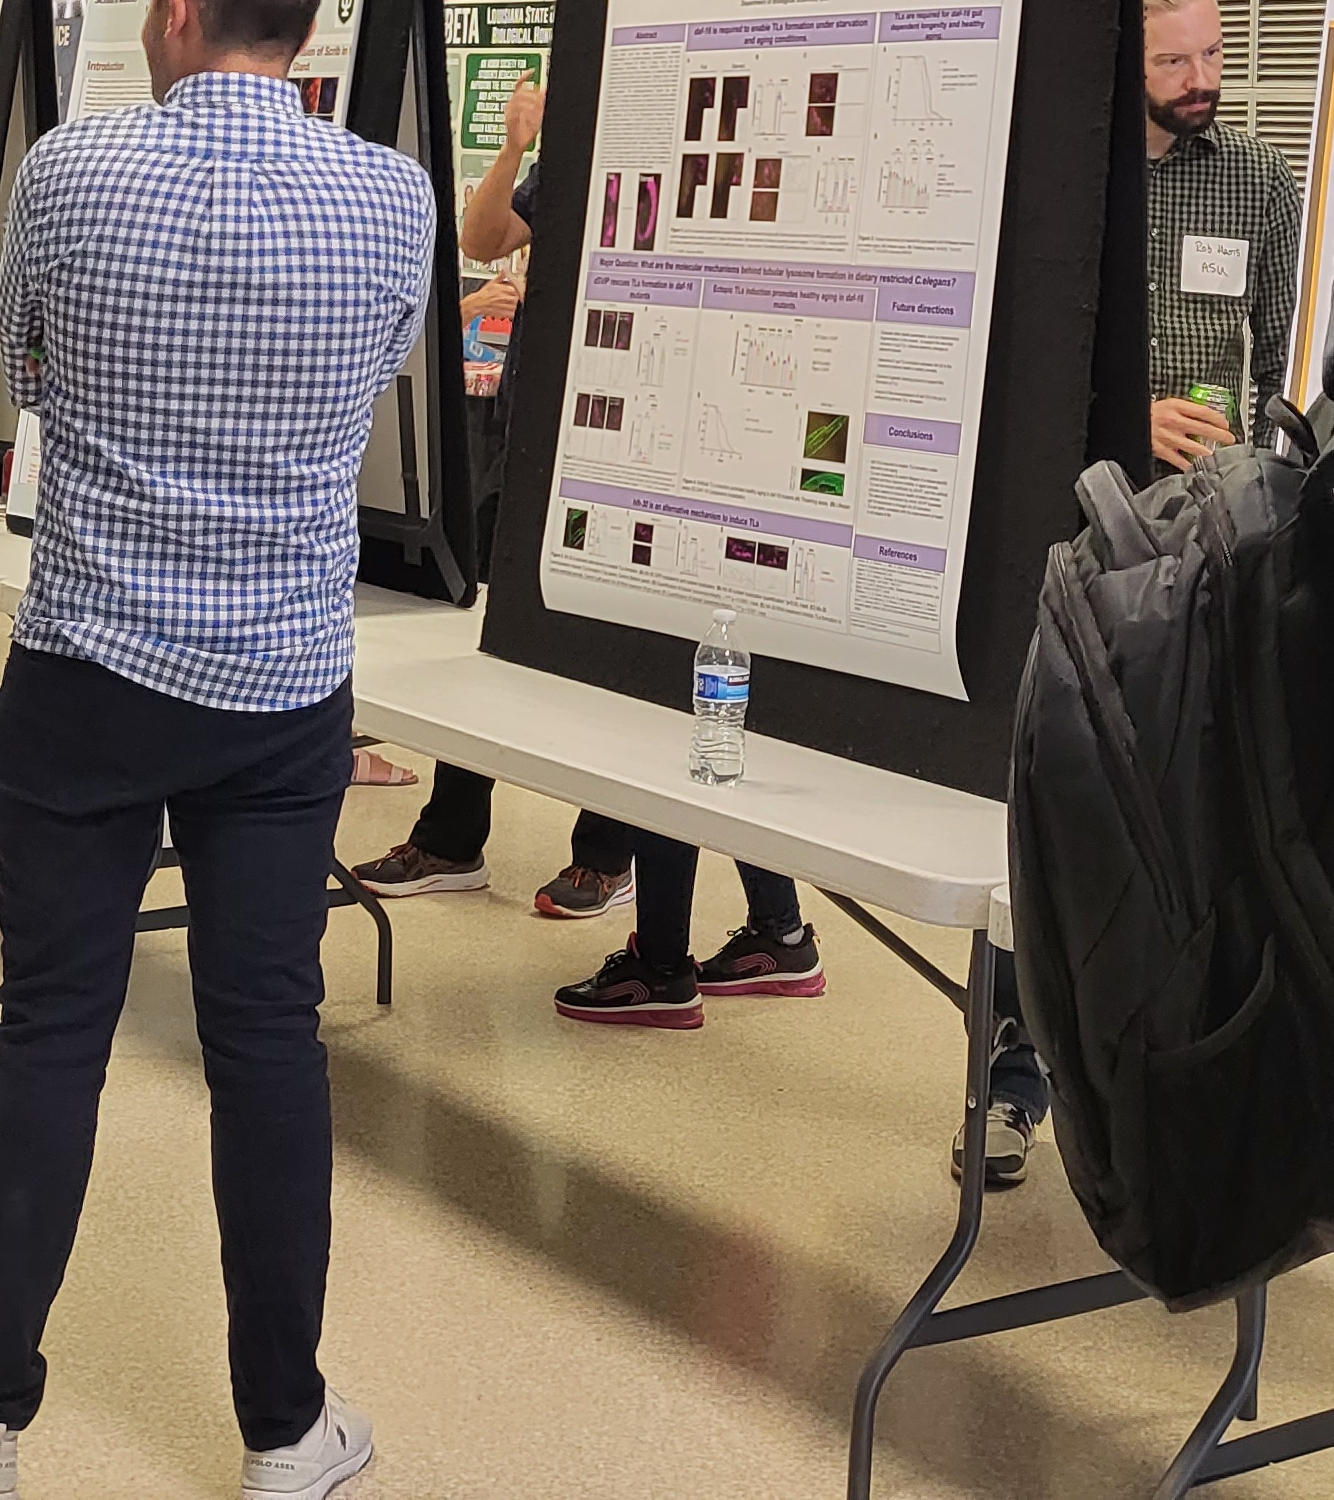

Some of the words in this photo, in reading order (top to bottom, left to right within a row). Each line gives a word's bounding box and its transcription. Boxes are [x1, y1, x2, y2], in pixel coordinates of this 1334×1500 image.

[525, 6, 549, 23] STATE
[879, 274, 913, 285] restricted
[892, 301, 915, 312] Future
[918, 303, 954, 315] directions
[888, 425, 934, 442] Conclusions
[879, 545, 917, 561] References
